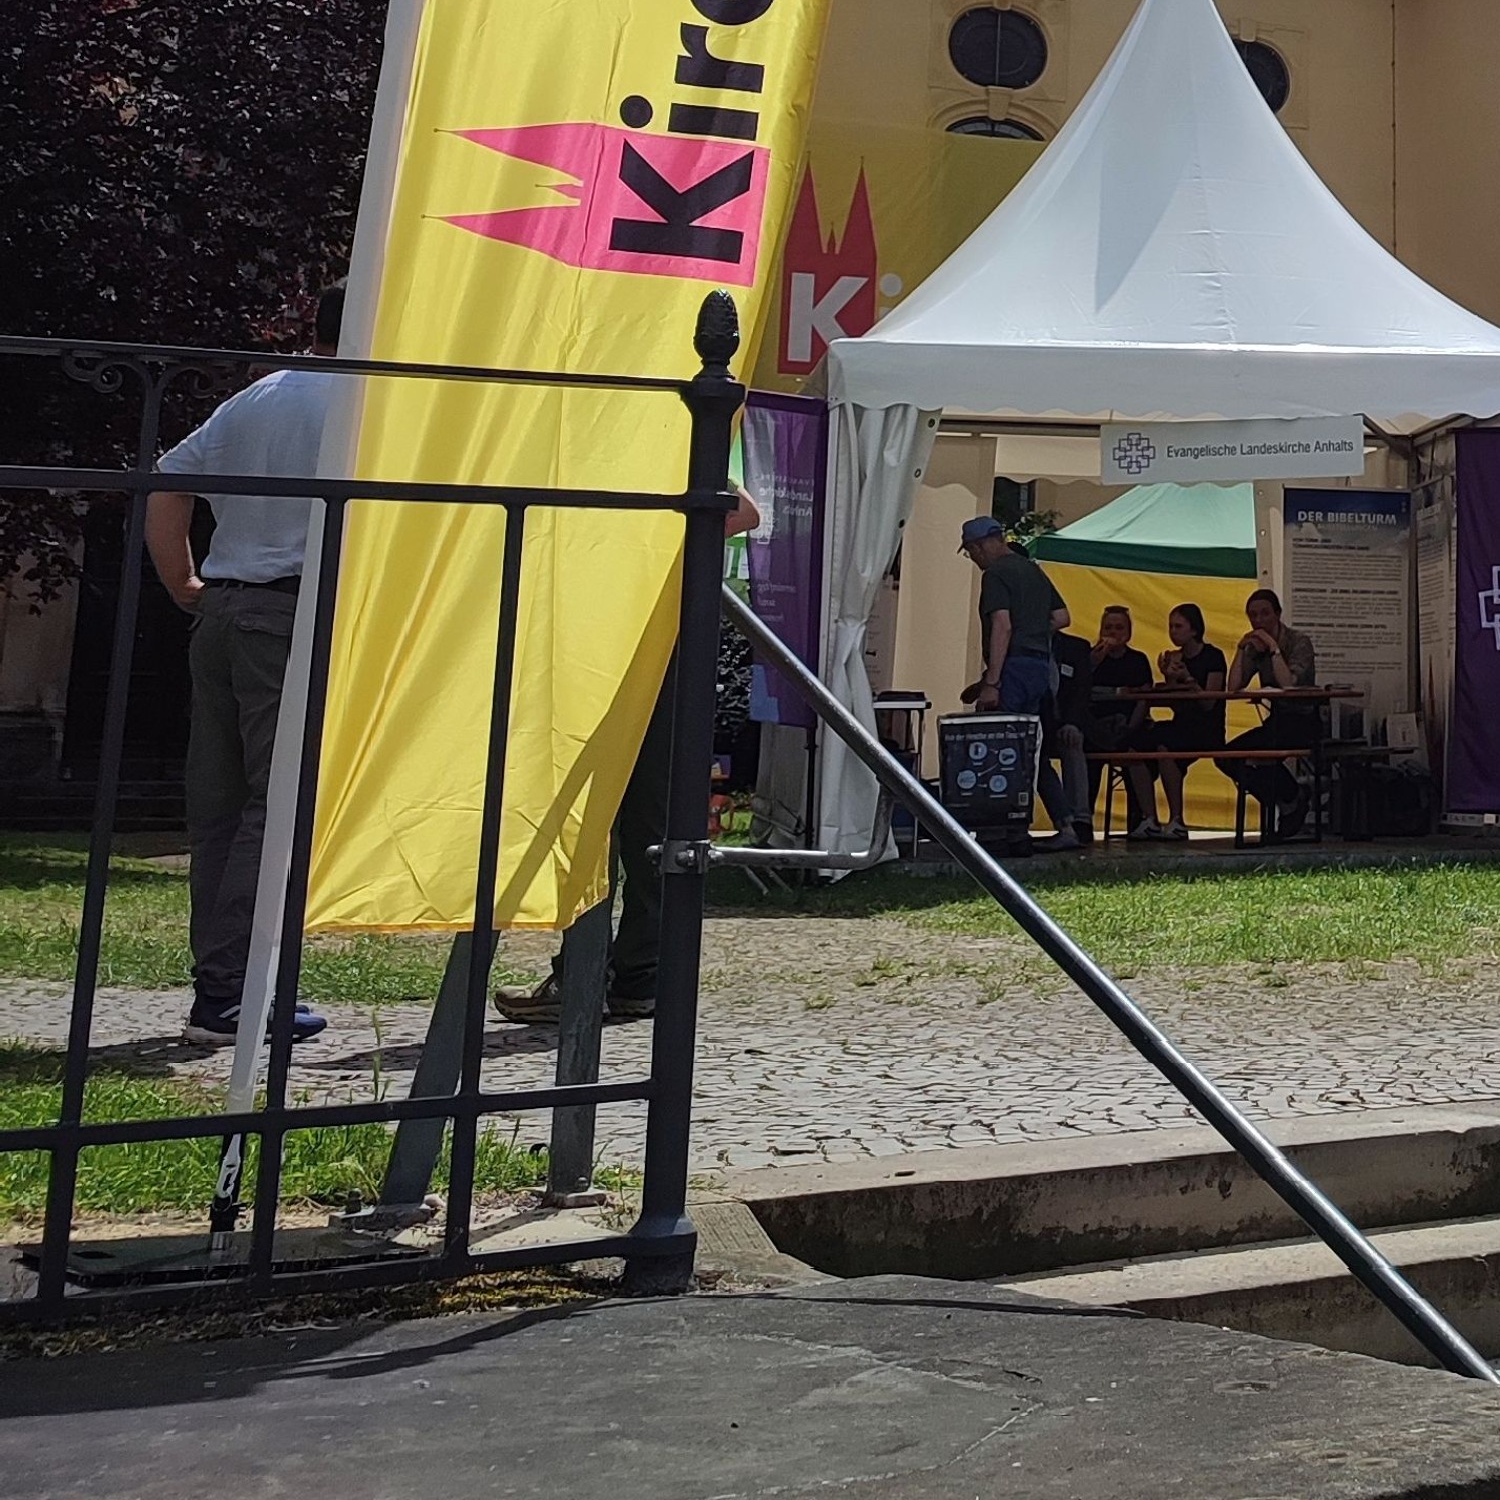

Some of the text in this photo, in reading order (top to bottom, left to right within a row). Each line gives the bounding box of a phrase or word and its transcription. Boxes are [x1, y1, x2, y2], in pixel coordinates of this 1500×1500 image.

[1166, 439, 1354, 459] Evangelische Landeskirche Anhalts
[1297, 510, 1397, 526] DER BIBELTURM
